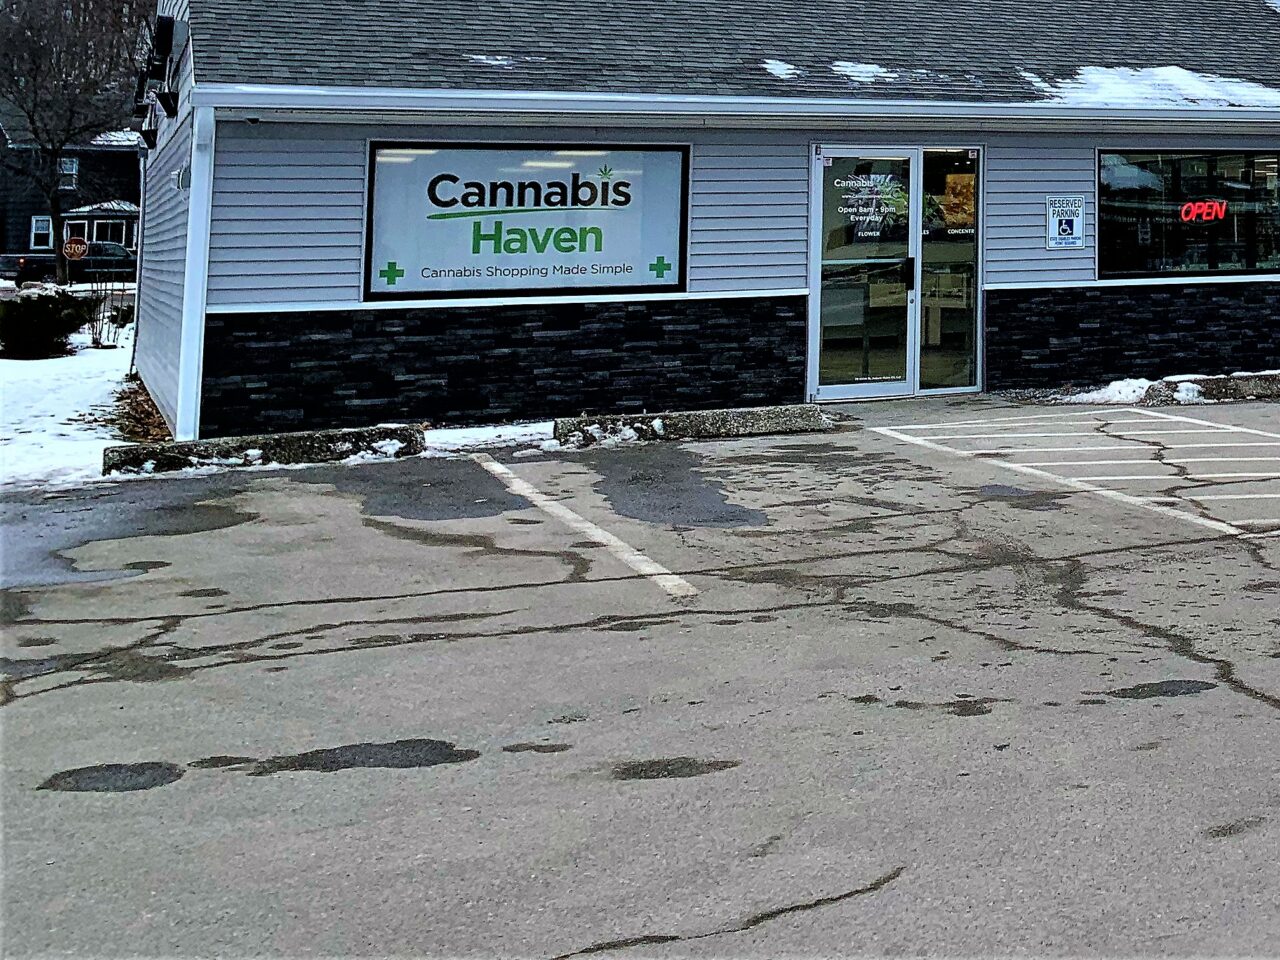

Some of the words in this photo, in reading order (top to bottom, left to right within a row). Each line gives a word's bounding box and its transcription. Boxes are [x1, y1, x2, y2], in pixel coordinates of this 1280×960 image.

[834, 178, 874, 187] Cannabis
[427, 168, 632, 208] Cannabis
[1049, 199, 1082, 208] RESERVED
[837, 206, 857, 214] Open
[1052, 209, 1080, 218] PARKING
[1180, 200, 1227, 222] OPEN
[850, 214, 883, 222] Everyday
[471, 221, 603, 254] Haven
[65, 244, 87, 253] STOP
[421, 265, 482, 279] Cannabis
[486, 264, 549, 279] Shopping
[552, 263, 588, 275] Made
[591, 263, 634, 278] Simple
